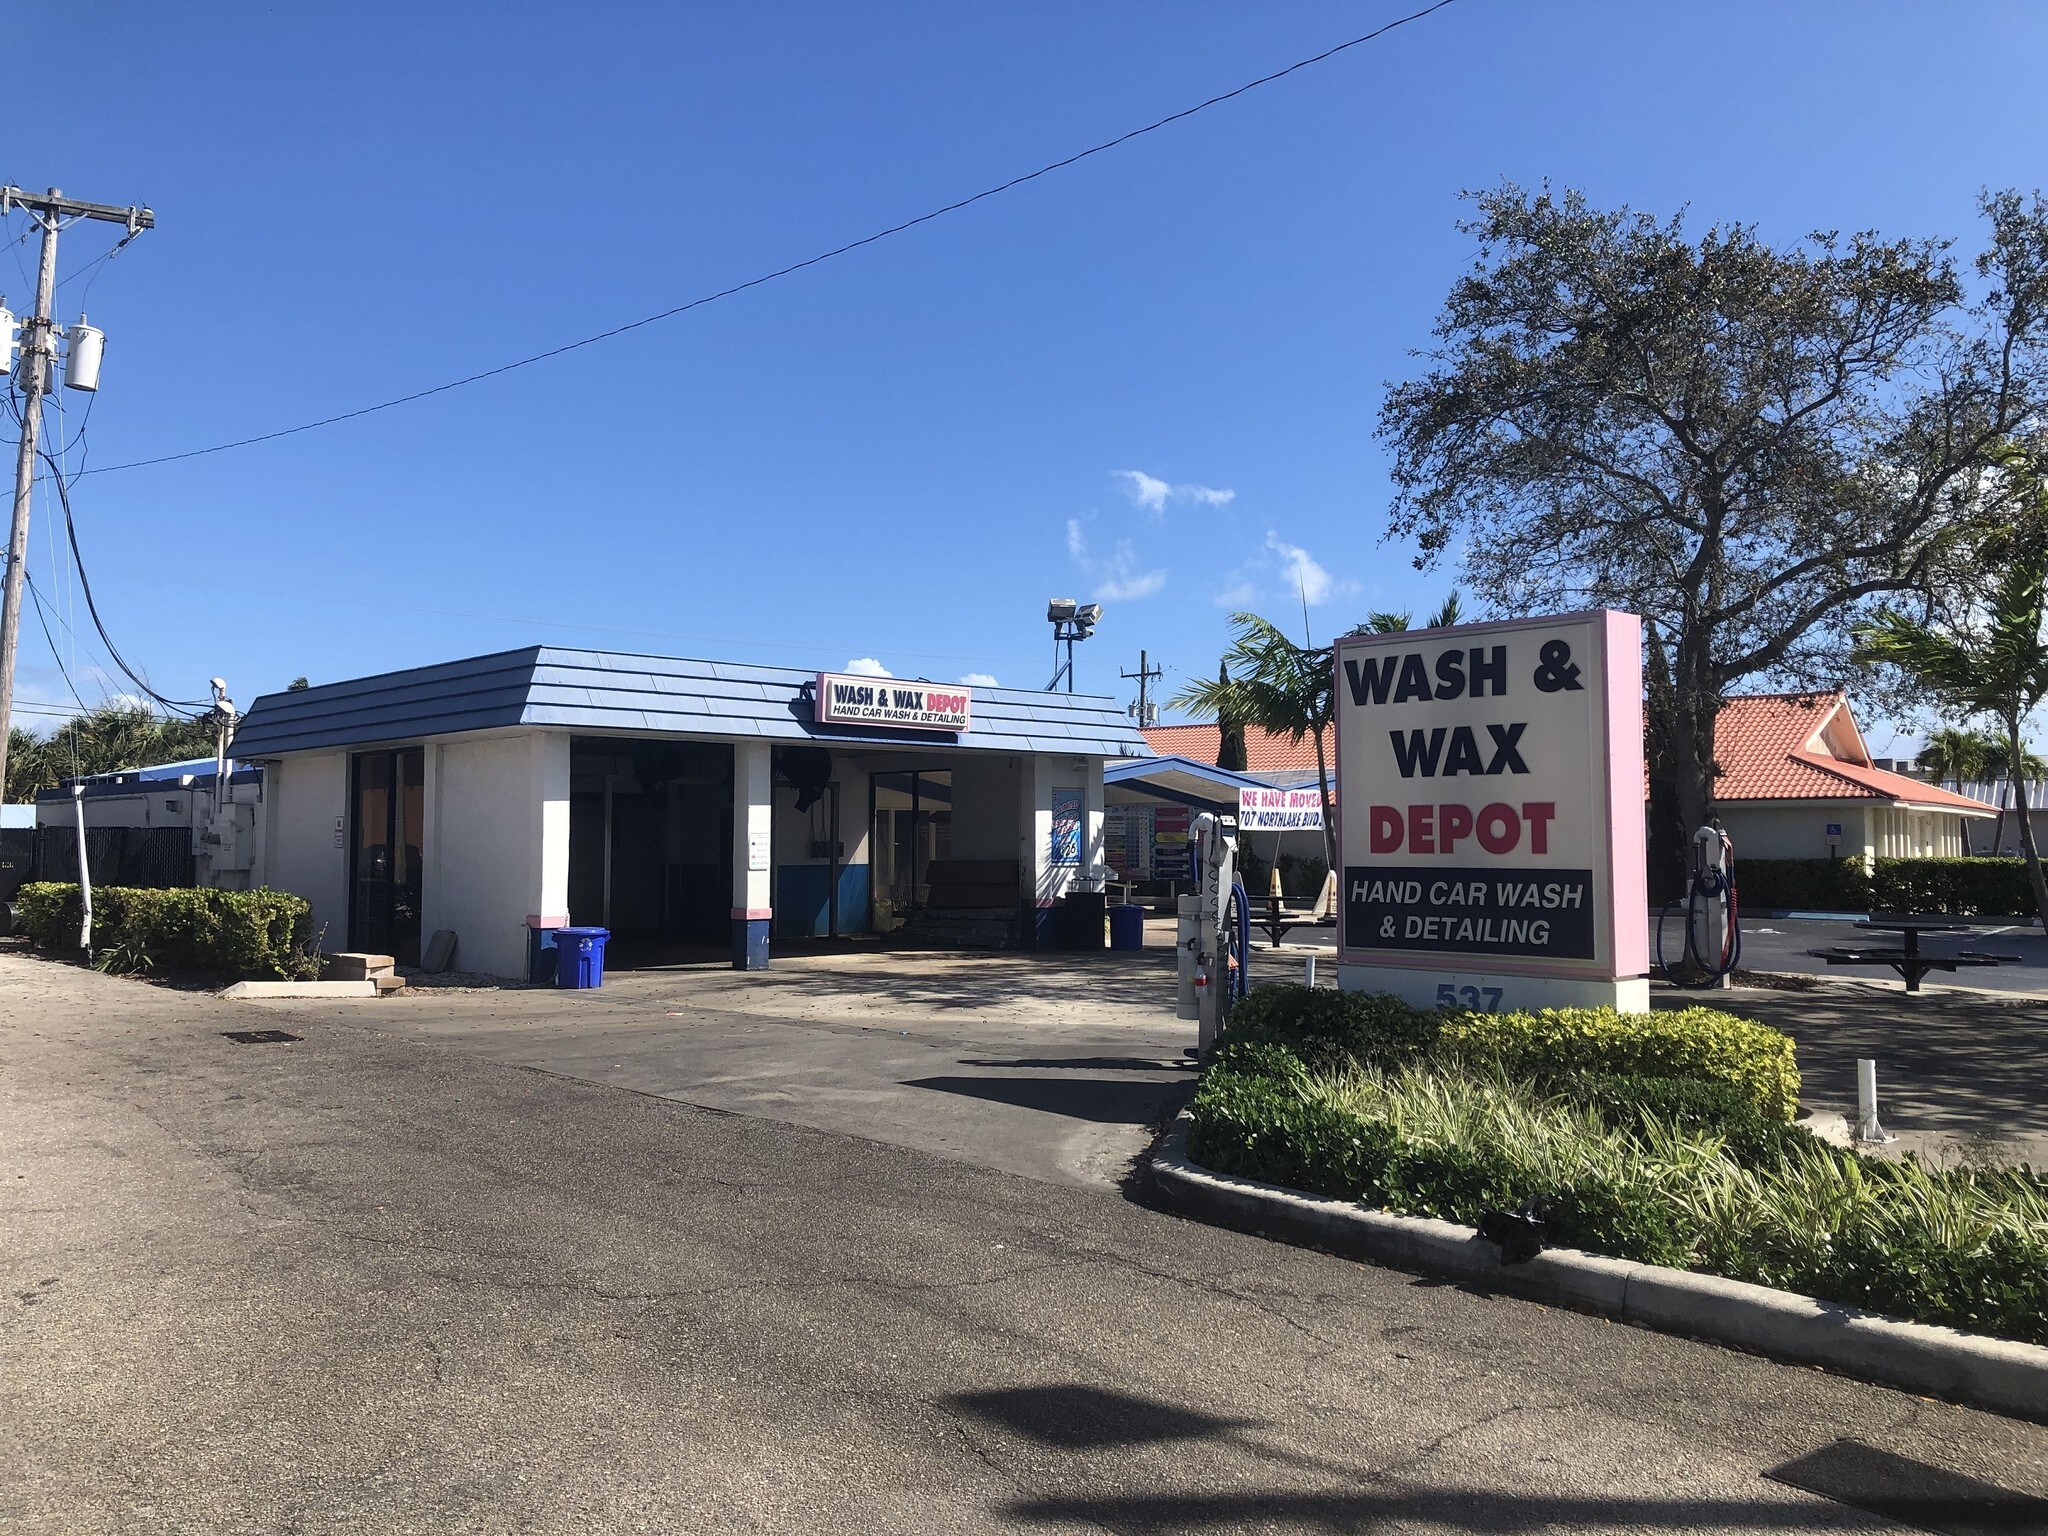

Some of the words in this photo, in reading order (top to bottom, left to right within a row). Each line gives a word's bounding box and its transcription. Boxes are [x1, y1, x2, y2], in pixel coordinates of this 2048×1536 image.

[1344, 645, 1507, 706] WASH
[1533, 639, 1584, 693] &
[833, 684, 874, 707] WASH
[878, 688, 888, 708] &
[892, 689, 923, 710] WAX
[926, 693, 967, 714] DEPOT
[833, 705, 860, 716] HAND
[862, 707, 881, 718] CAR
[884, 709, 911, 720] WASH
[912, 712, 919, 721] &
[921, 712, 966, 724] DETAILING
[1389, 722, 1530, 778] WAX
[1242, 791, 1257, 807] WE
[1261, 791, 1286, 808] HAVE
[1290, 792, 1322, 808] MOVED
[1240, 811, 1256, 827] 707
[1257, 811, 1302, 827] NORTHLAKE
[1370, 802, 1556, 855] DEPOT
[1351, 880, 1422, 905] HAND
[1429, 881, 1487, 906] CAR
[1497, 883, 1584, 909] WASH
[1379, 915, 1396, 939] &
[1404, 916, 1550, 945] DETAILING
[1436, 984, 1503, 1014] 537
